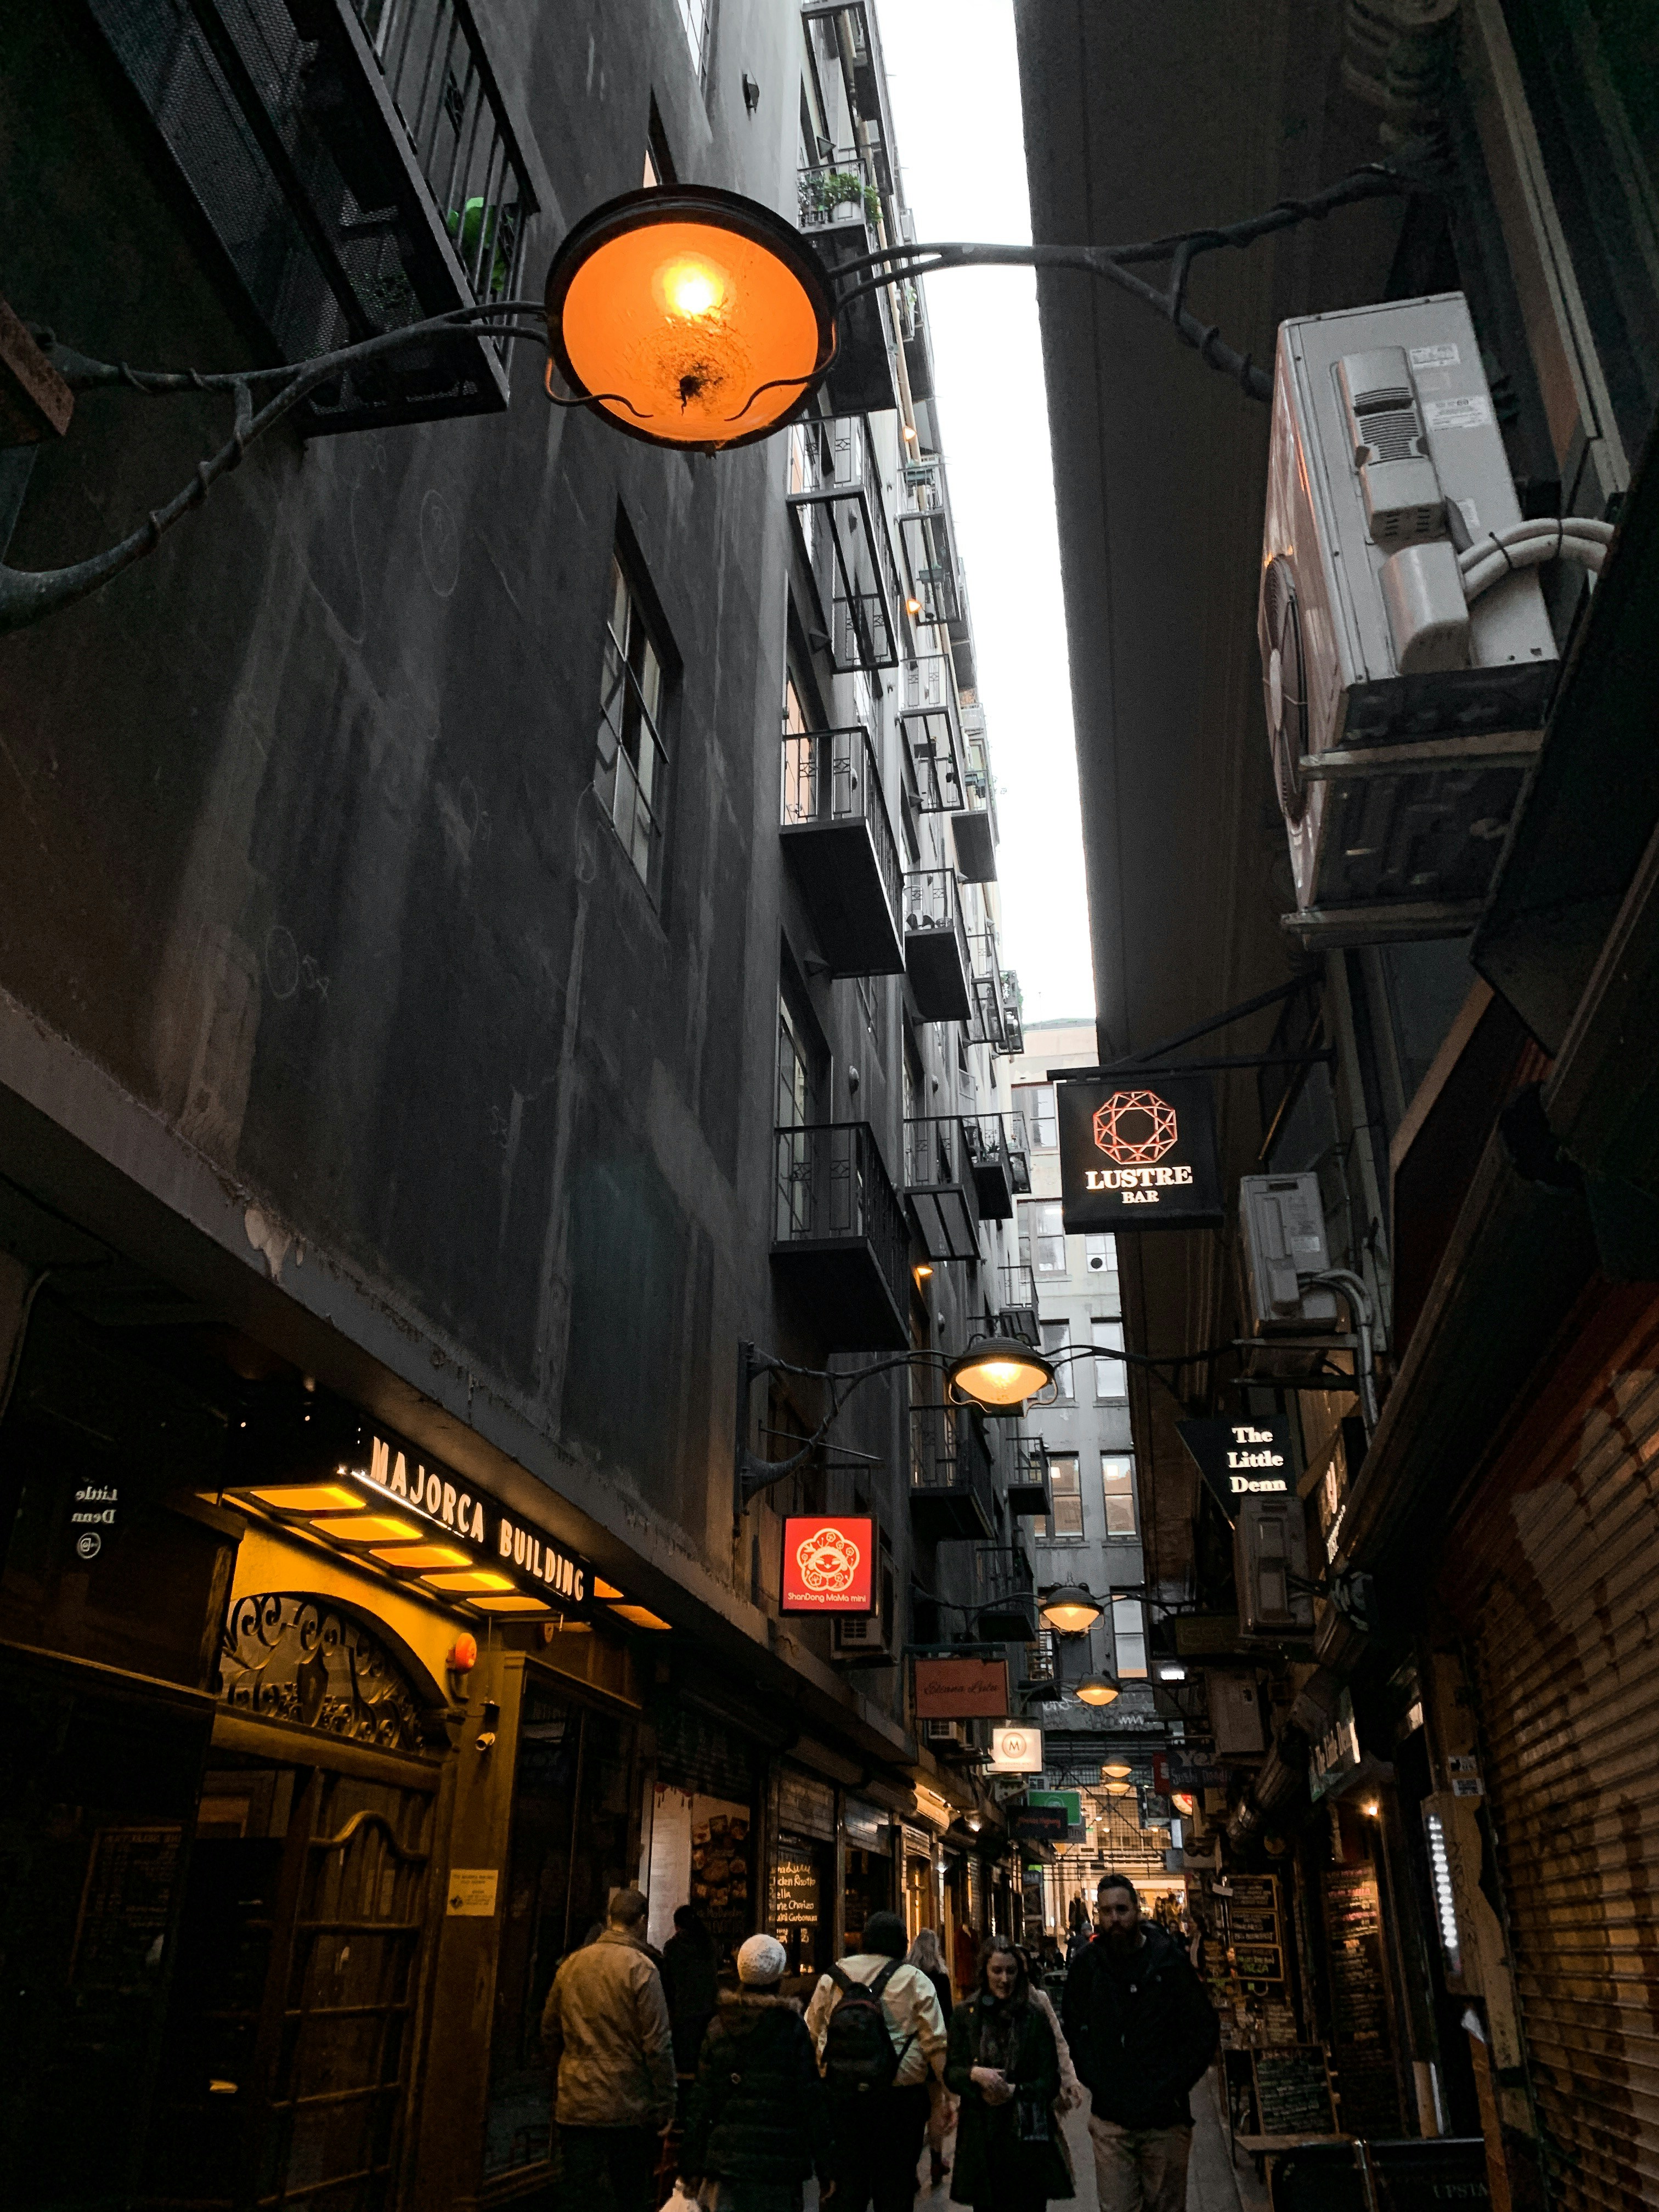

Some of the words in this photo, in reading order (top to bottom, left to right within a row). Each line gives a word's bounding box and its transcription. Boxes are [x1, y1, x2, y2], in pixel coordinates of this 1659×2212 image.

[1085, 1166, 1193, 1190] LUSTRE
[1121, 1190, 1160, 1204] BAR
[1232, 1427, 1273, 1443] The
[1227, 1451, 1284, 1468] Little
[1229, 1476, 1288, 1493] Denn
[370, 1436, 484, 1543] MAJORCA
[499, 1518, 584, 1601] BUILDING
[788, 1592, 825, 1603] ShanDong
[826, 1593, 849, 1602] MaMa
[1008, 1740, 1020, 1751] M
